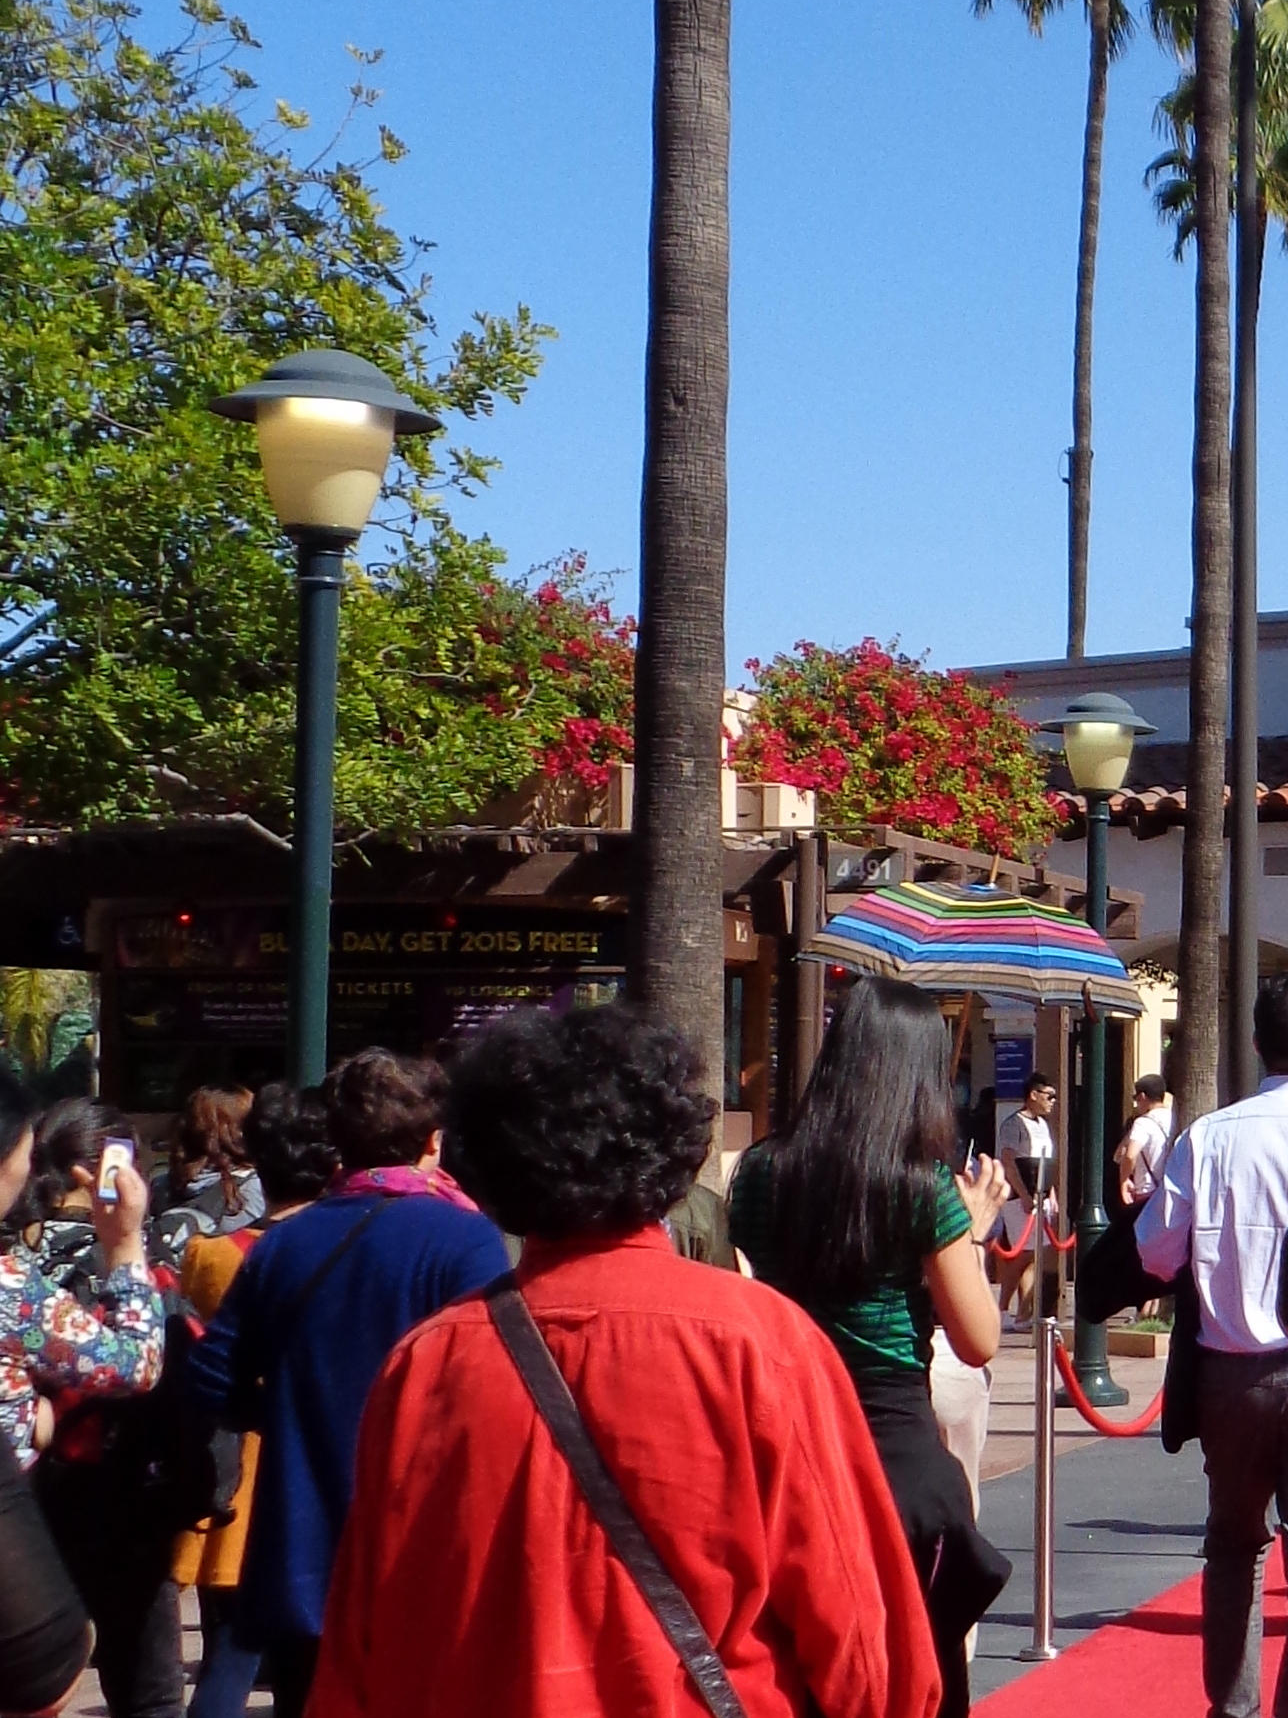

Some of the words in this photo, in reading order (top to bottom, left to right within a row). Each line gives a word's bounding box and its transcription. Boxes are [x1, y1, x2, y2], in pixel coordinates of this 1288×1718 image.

[836, 857, 891, 880] 4491
[260, 931, 289, 954] BU
[342, 931, 393, 954] DAY,
[399, 931, 453, 953] GET
[460, 930, 522, 953] 2015
[336, 982, 414, 995] TICKETS
